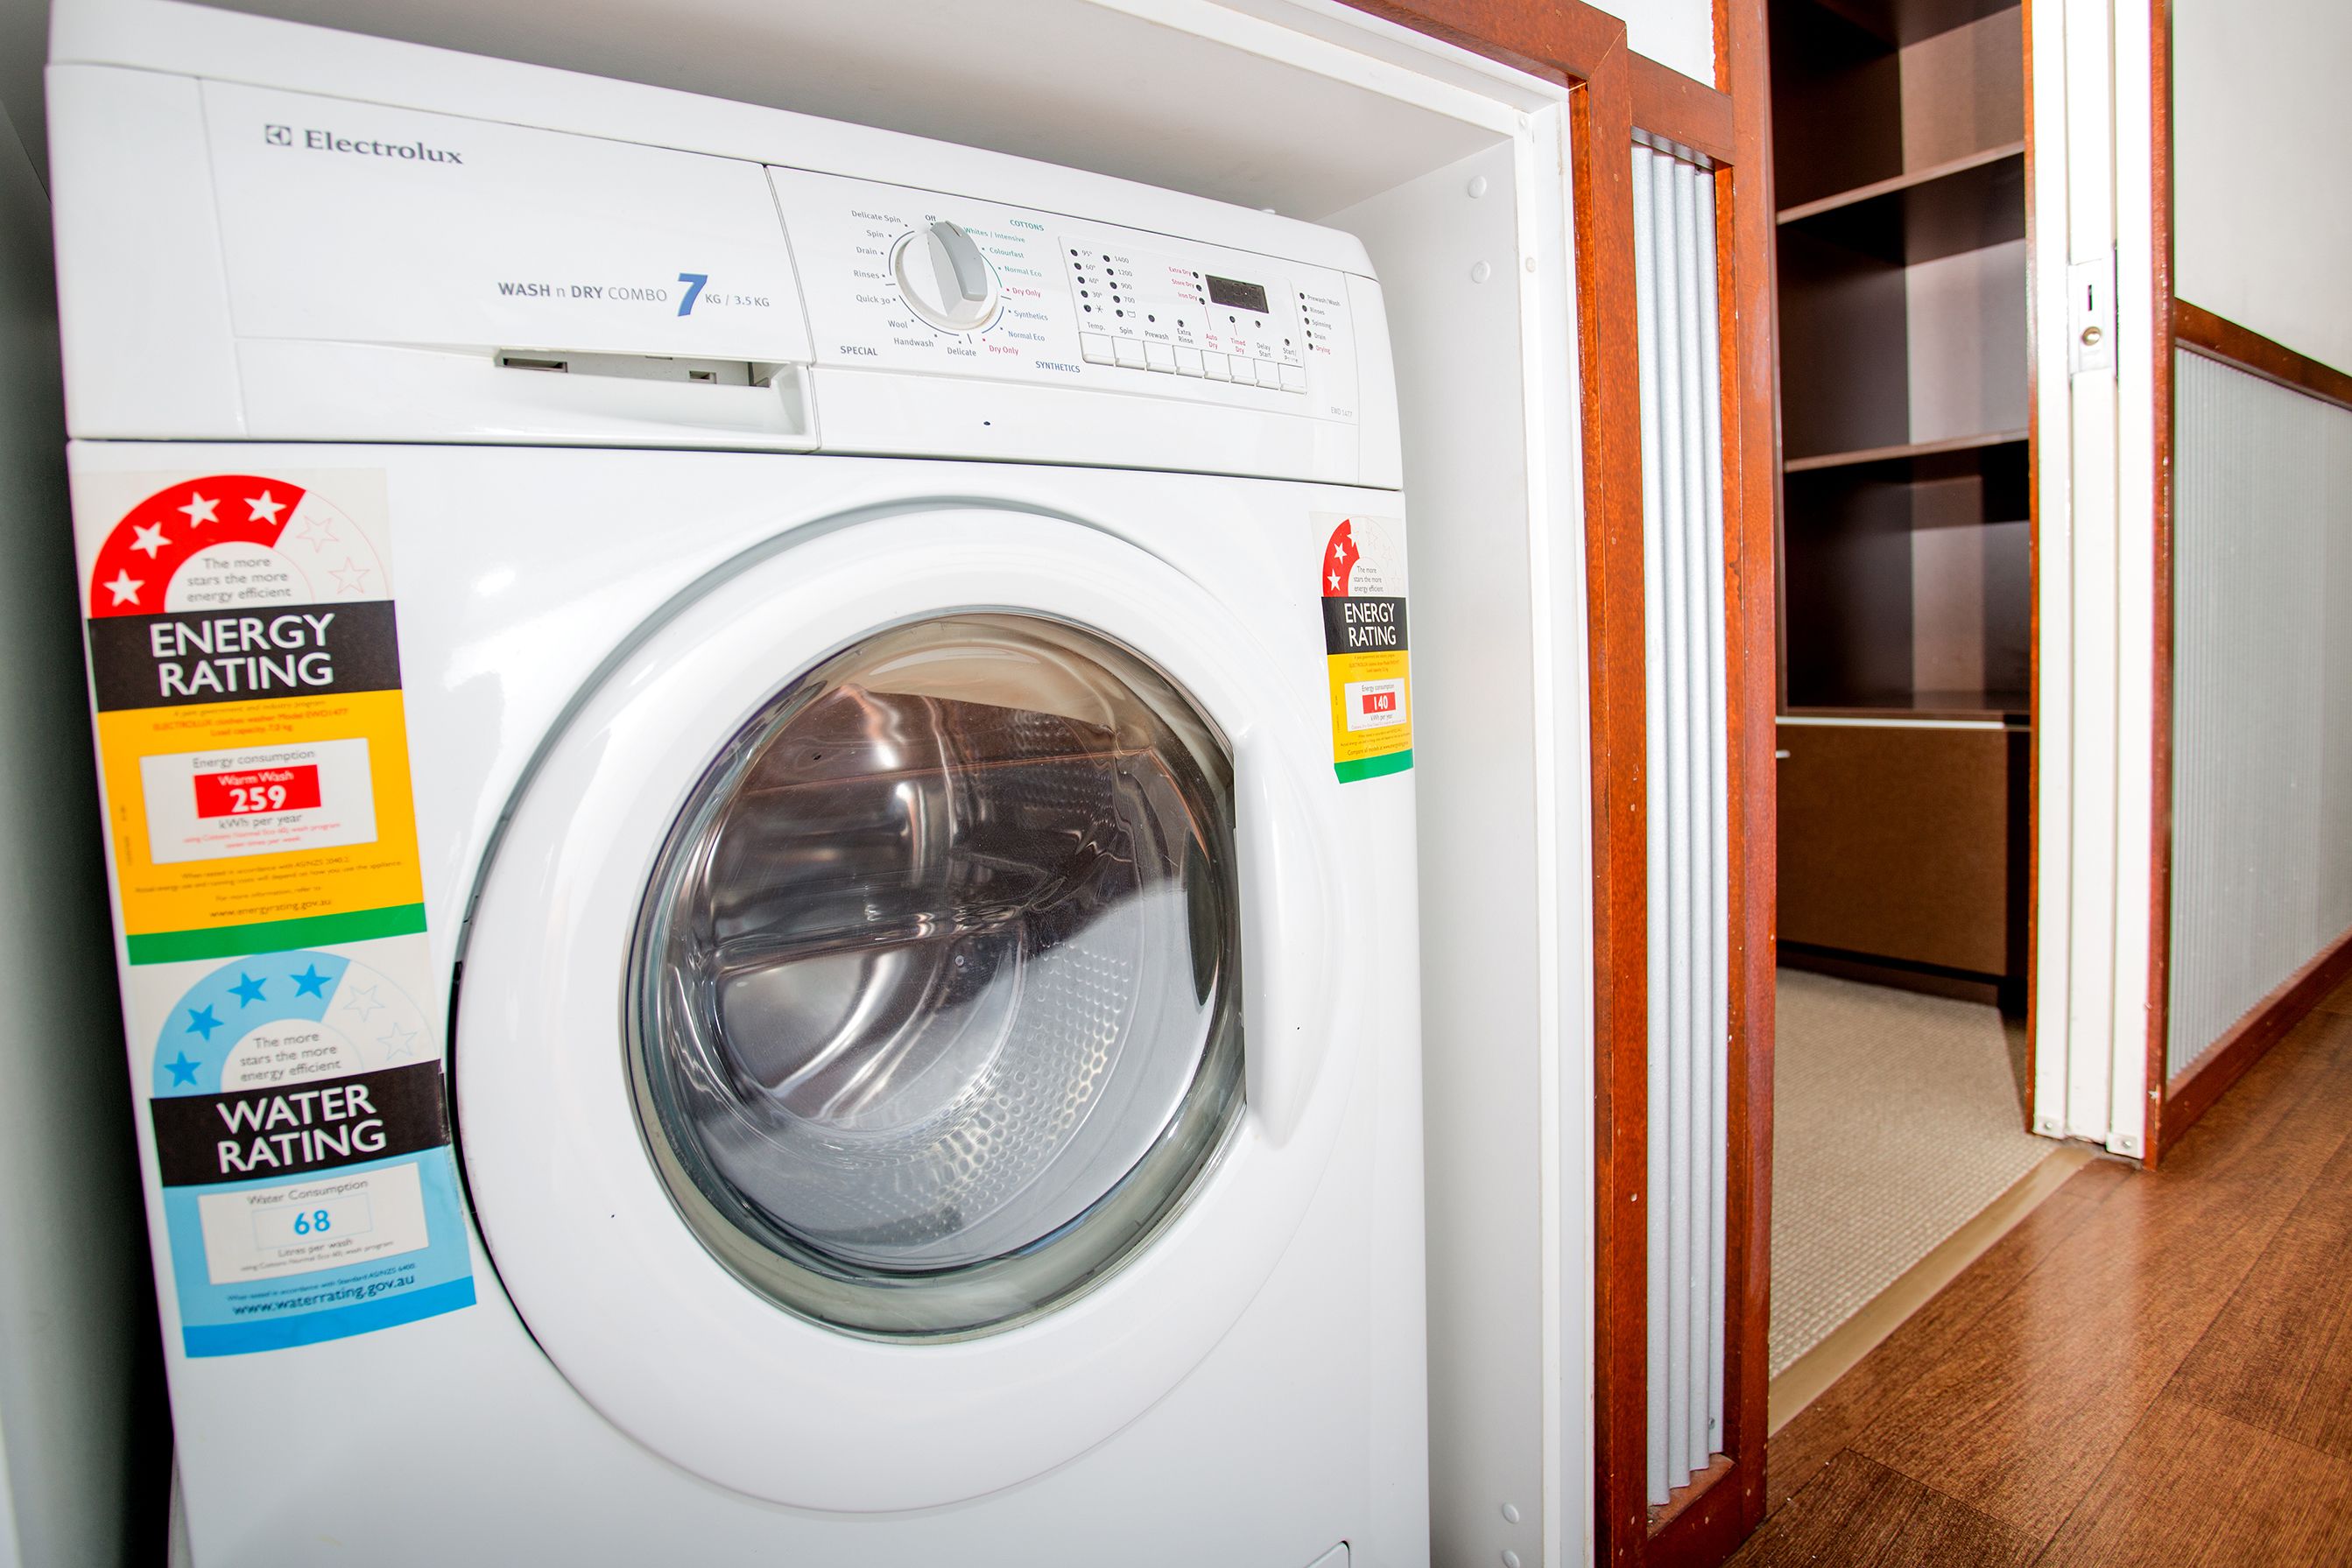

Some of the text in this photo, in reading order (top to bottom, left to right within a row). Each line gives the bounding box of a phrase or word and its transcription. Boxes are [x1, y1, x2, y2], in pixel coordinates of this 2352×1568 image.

[305, 129, 463, 165] Electrolux
[851, 210, 902, 224] Delicate Spin
[1010, 219, 1045, 231] COTTONS
[866, 229, 884, 239] Spin
[994, 232, 1025, 243] Intensive
[856, 246, 877, 256] Drain
[989, 247, 1025, 259] Colourfast
[853, 270, 880, 280] Rinses
[1004, 265, 1042, 278] Normal Eco
[498, 282, 551, 297] WASH
[556, 285, 566, 298] n
[570, 285, 602, 299] DRY
[609, 286, 667, 302] COMBO
[677, 272, 708, 317] 7
[705, 293, 722, 306] KG
[735, 295, 752, 306] 3.5
[754, 297, 770, 308] KG
[856, 294, 879, 304] Quick
[1011, 287, 1041, 299] Dry Only
[1013, 310, 1049, 321] Synthetics
[888, 320, 908, 329] Wool
[1119, 326, 1133, 334] Spin
[1008, 330, 1046, 342] Normal Eco
[1144, 330, 1169, 341] Prewash
[1230, 337, 1246, 346] Timed
[893, 338, 934, 348] Handwash
[1208, 341, 1218, 349] Dry
[1257, 342, 1271, 352] Delay
[840, 346, 878, 356] SPECIAL
[947, 347, 976, 357] Delicate
[989, 345, 1019, 356] Dry Only
[1235, 346, 1244, 355] Dry
[1035, 361, 1081, 373] SYNTHETICS
[202, 558, 271, 570] The more
[187, 573, 288, 587] stars the more
[187, 586, 292, 604] energy efficient
[1354, 584, 1384, 594] energy efficient
[1344, 602, 1395, 623] ENERGY
[151, 612, 335, 657] ENERGY
[1349, 625, 1396, 647] RATING
[158, 652, 334, 698] RATING
[1373, 694, 1388, 711] 140
[193, 749, 315, 769] Energy consumption
[218, 770, 294, 787] Warm Wash
[229, 784, 286, 813] 259
[218, 813, 302, 831] kWh per year
[254, 1032, 320, 1049] The more
[240, 1045, 338, 1066] stars the more
[240, 1060, 342, 1083] energy efficient
[216, 1084, 377, 1135] WATER
[217, 1119, 386, 1174] RATING
[247, 1178, 369, 1206] Water Consumption
[293, 1209, 331, 1235] 68
[308, 1244, 325, 1255] per
[329, 1238, 354, 1249] wash
[232, 1275, 415, 1316] www.waterrating.gov.au
